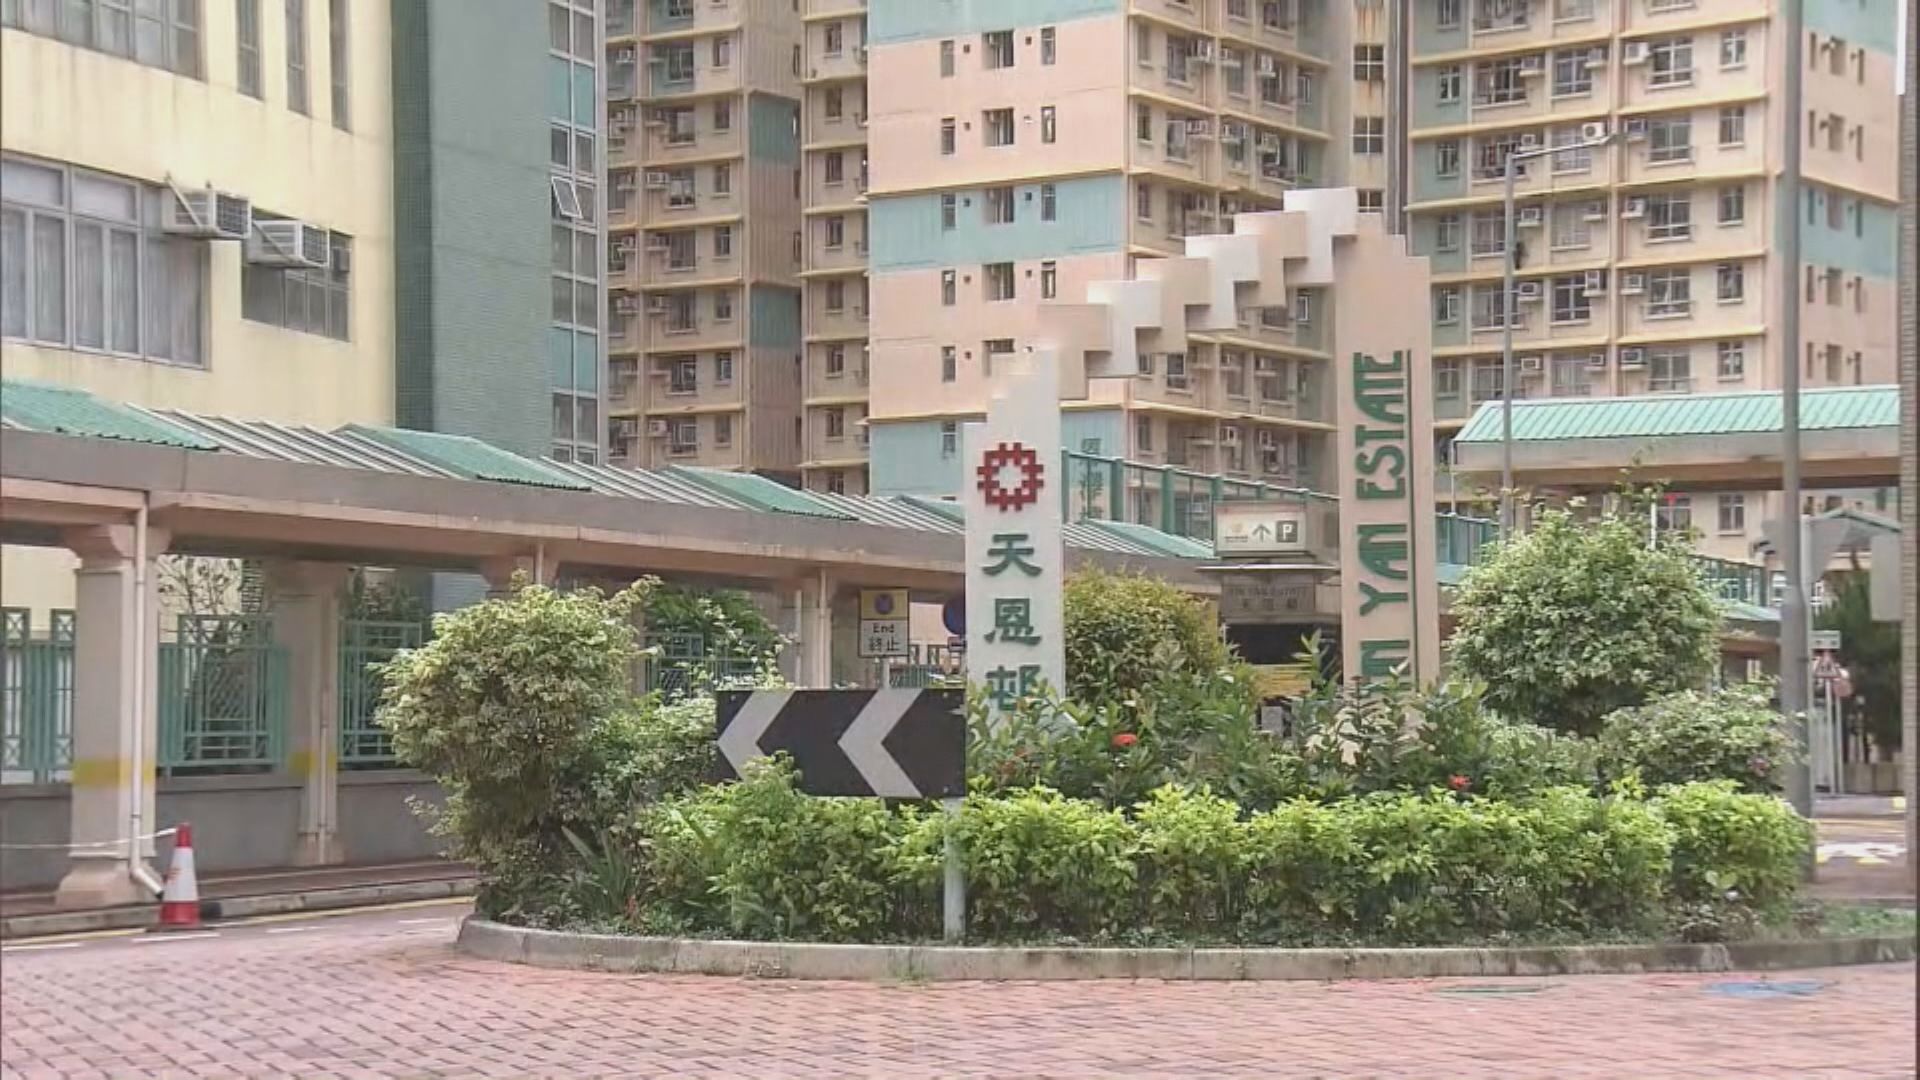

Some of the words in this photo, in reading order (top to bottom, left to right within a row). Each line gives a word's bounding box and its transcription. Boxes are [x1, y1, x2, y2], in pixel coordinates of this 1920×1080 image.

[1353, 350, 1406, 500] ESTATE
[873, 623, 895, 633] End
[982, 533, 1044, 713] 天恩邨
[1357, 524, 1409, 617] YAN
